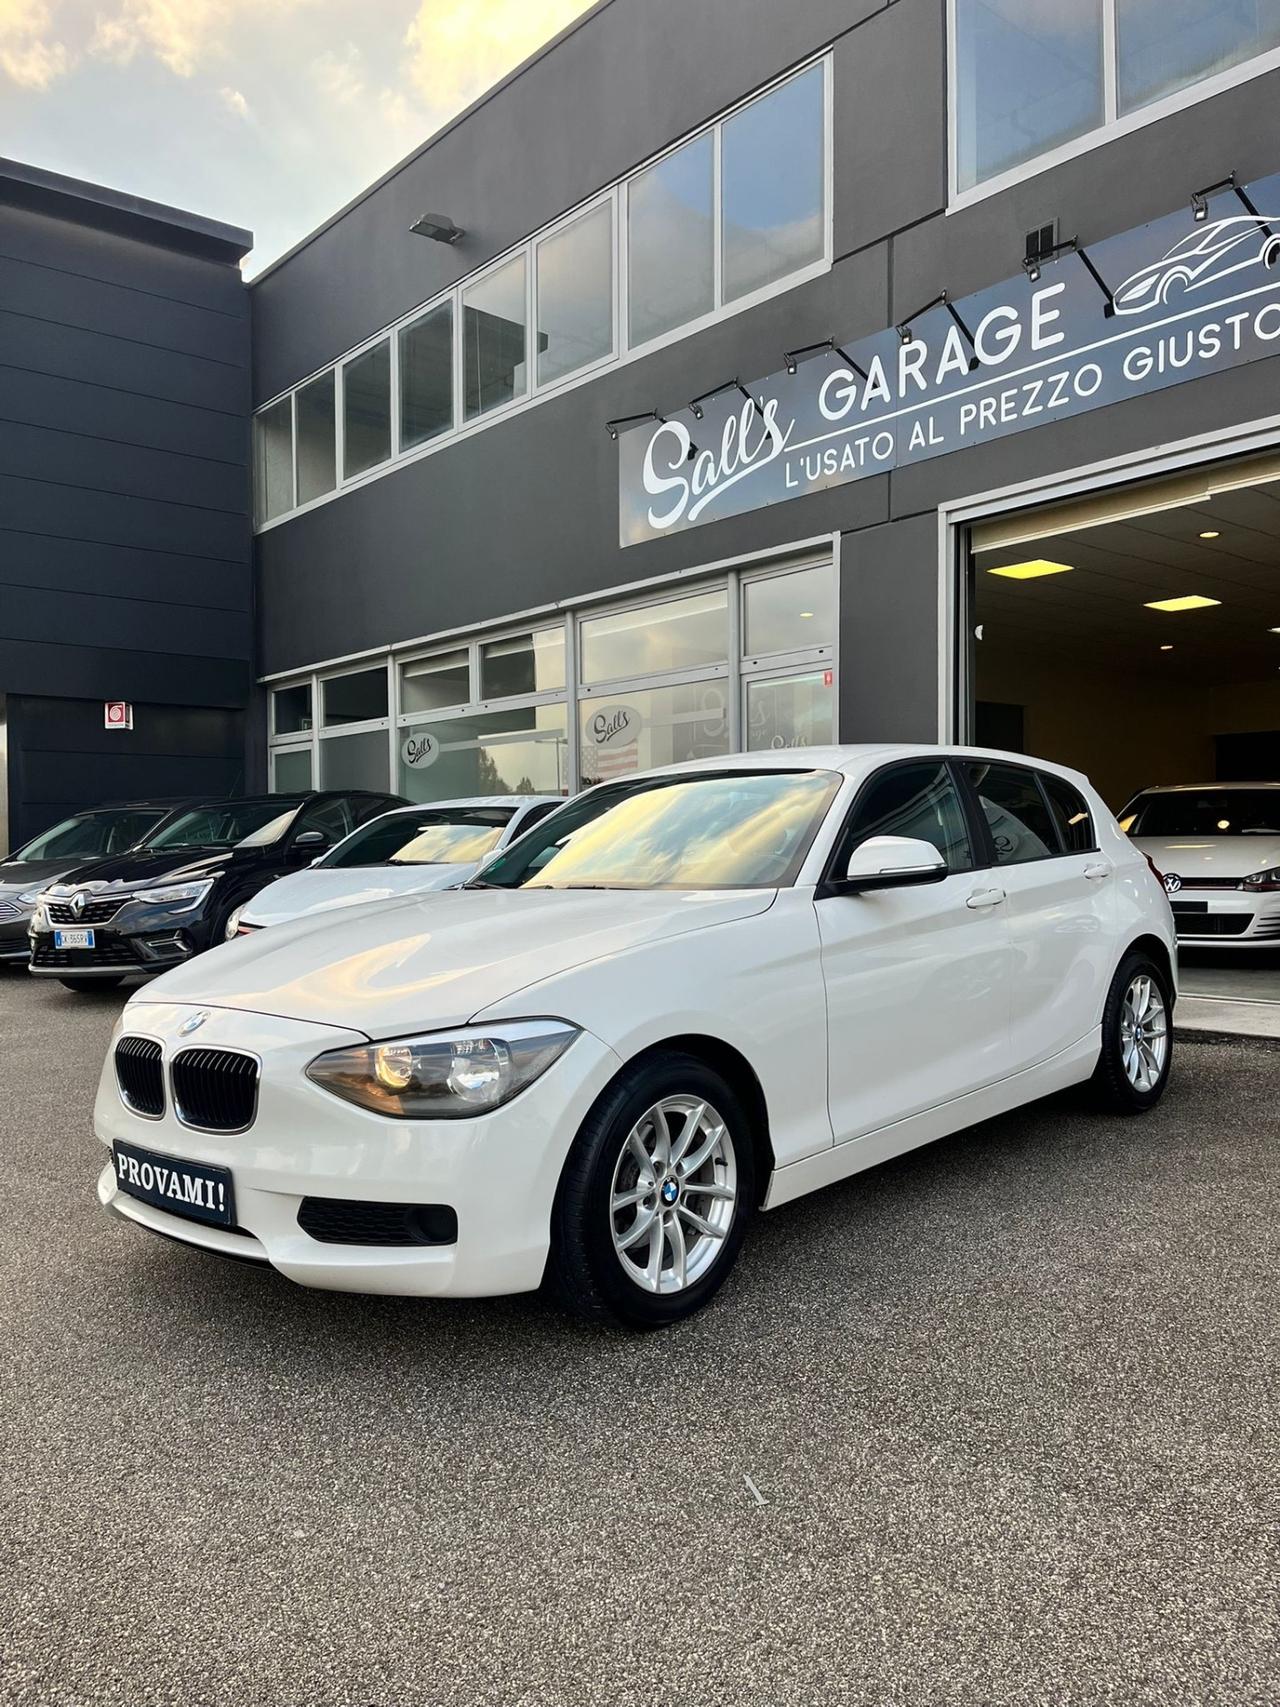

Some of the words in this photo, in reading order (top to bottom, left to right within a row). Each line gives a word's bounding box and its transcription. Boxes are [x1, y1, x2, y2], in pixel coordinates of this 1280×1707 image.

[642, 395, 796, 530] Sall's
[818, 282, 1066, 421] GARAGE
[785, 431, 895, 488] L'USATO
[908, 416, 944, 451] AL
[960, 363, 1103, 435] PREZZO
[1122, 303, 1280, 382] GIUSTO
[117, 1152, 226, 1212] PROVAMI!
